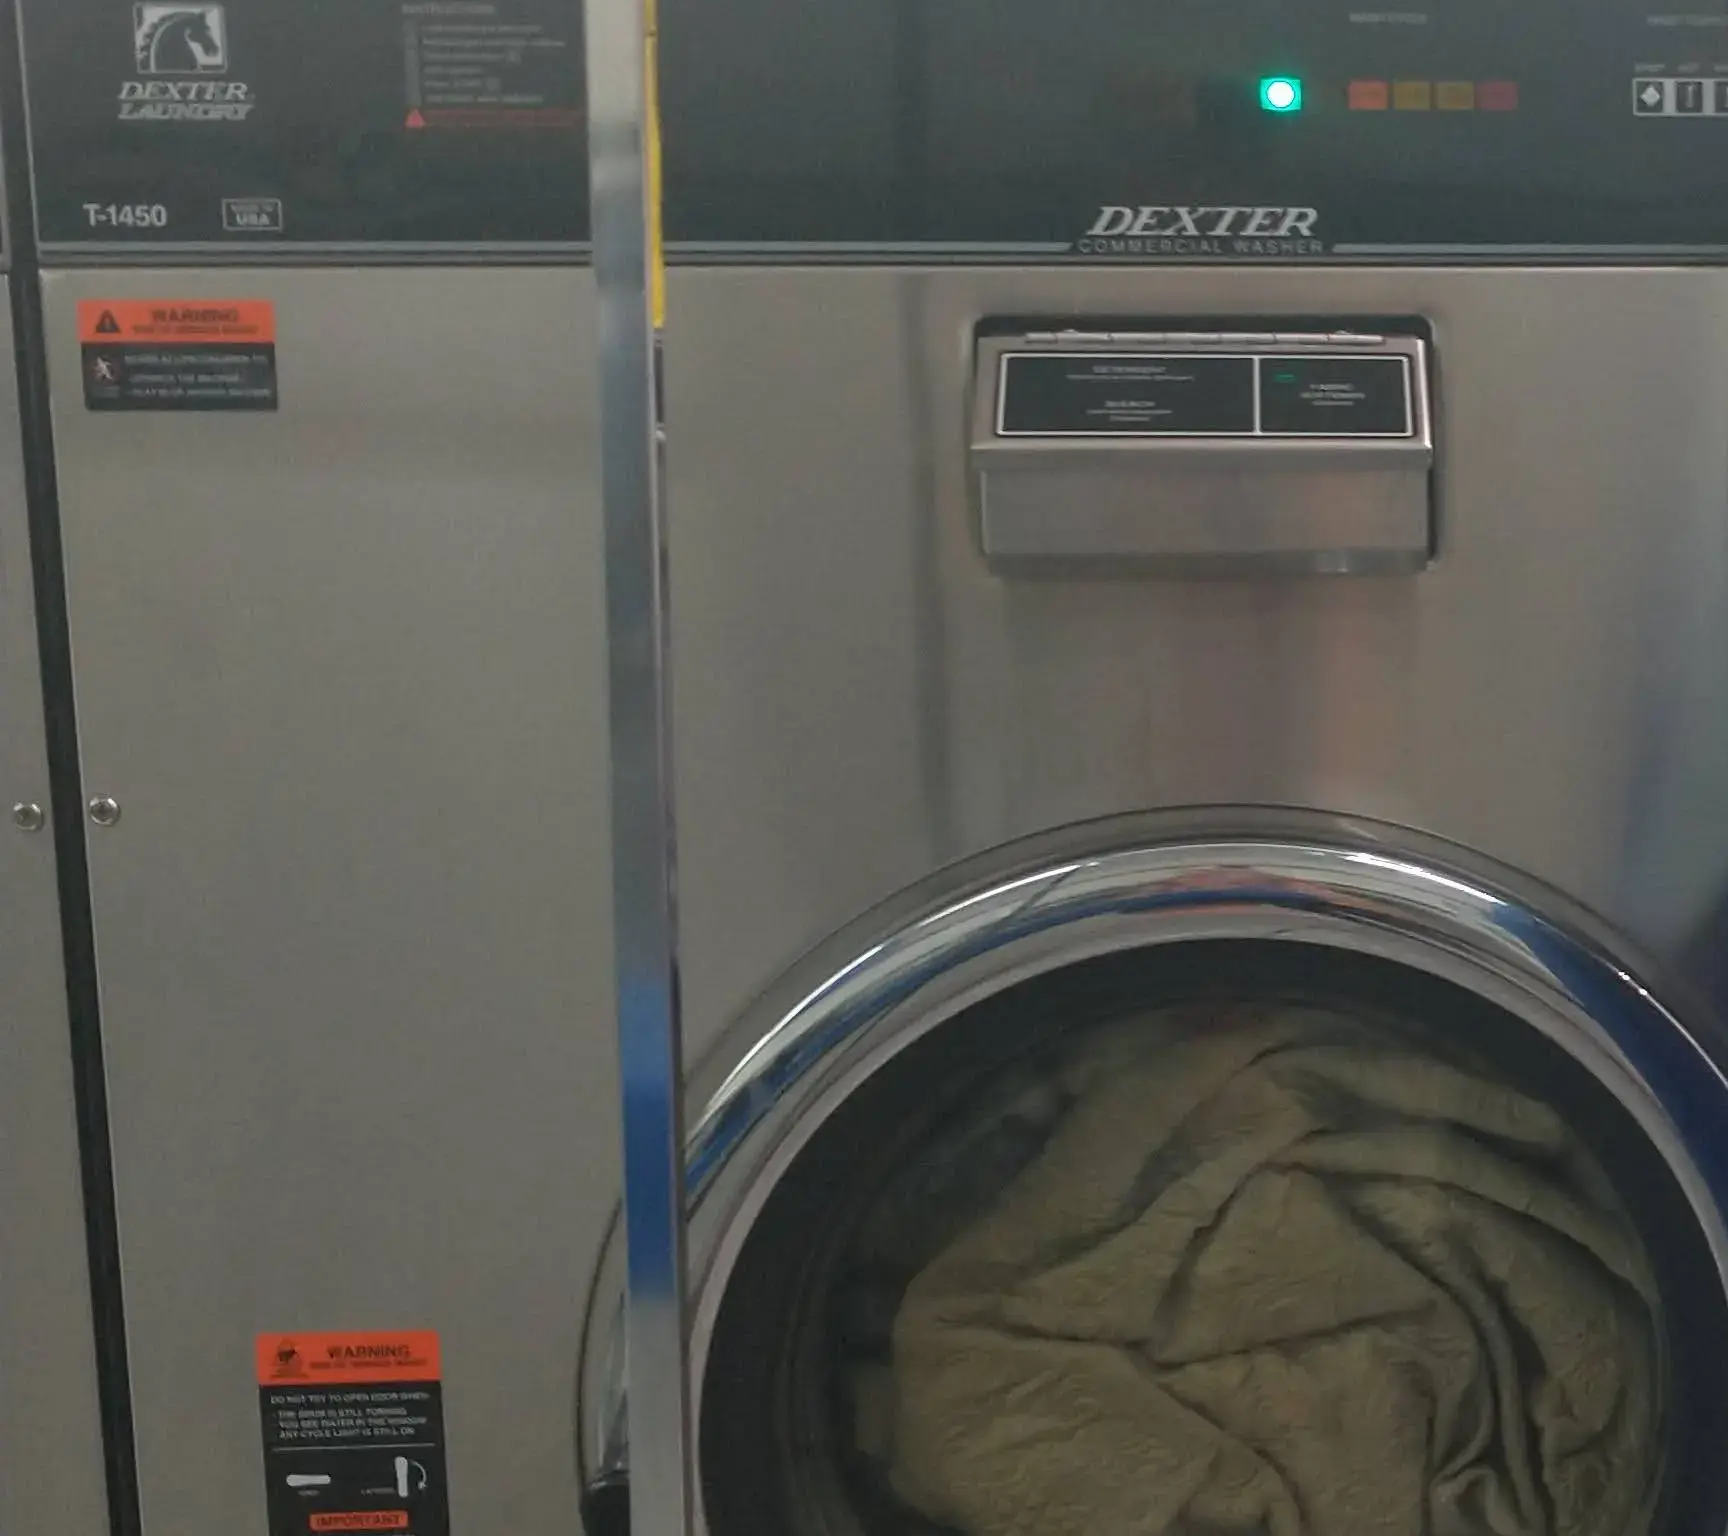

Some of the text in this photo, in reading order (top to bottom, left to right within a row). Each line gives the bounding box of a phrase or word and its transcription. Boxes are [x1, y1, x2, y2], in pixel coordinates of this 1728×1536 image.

[117, 80, 249, 101] DEXTER
[116, 101, 254, 121] LAUNDRY
[82, 203, 168, 228] T-1450
[1085, 205, 1319, 237] DEXTER
[1078, 237, 1324, 254] COMMERCIAL WASHER
[326, 1343, 412, 1359] WARNING
